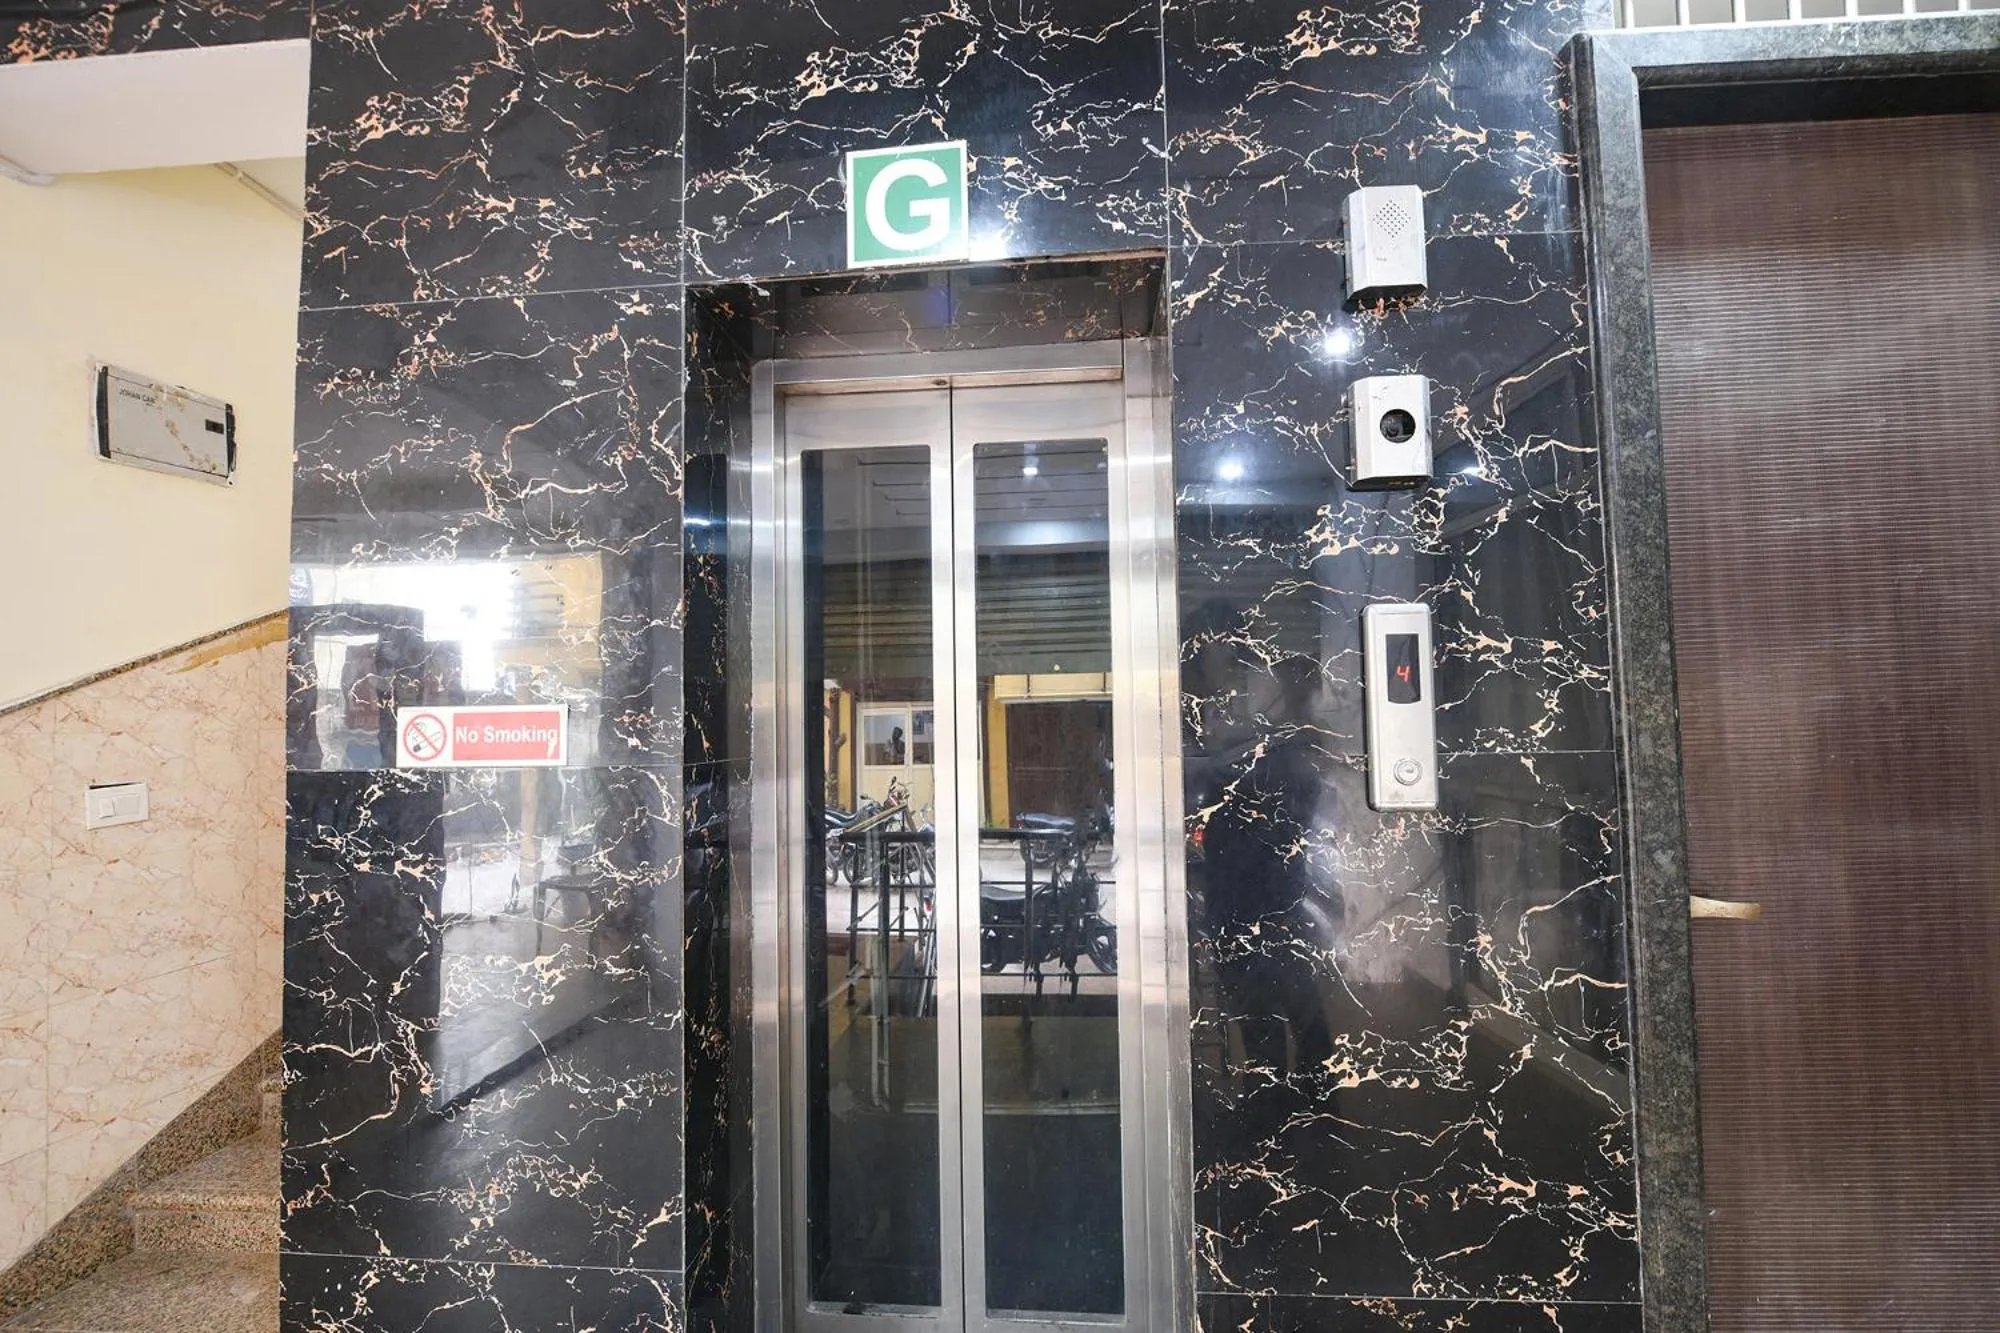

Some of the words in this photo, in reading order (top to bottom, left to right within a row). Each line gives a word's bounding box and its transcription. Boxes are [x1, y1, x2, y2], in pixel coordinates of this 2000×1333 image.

[865, 158, 950, 252] G
[1396, 665, 1412, 683] 4
[455, 726, 479, 744] No
[483, 725, 558, 758] Smoking
